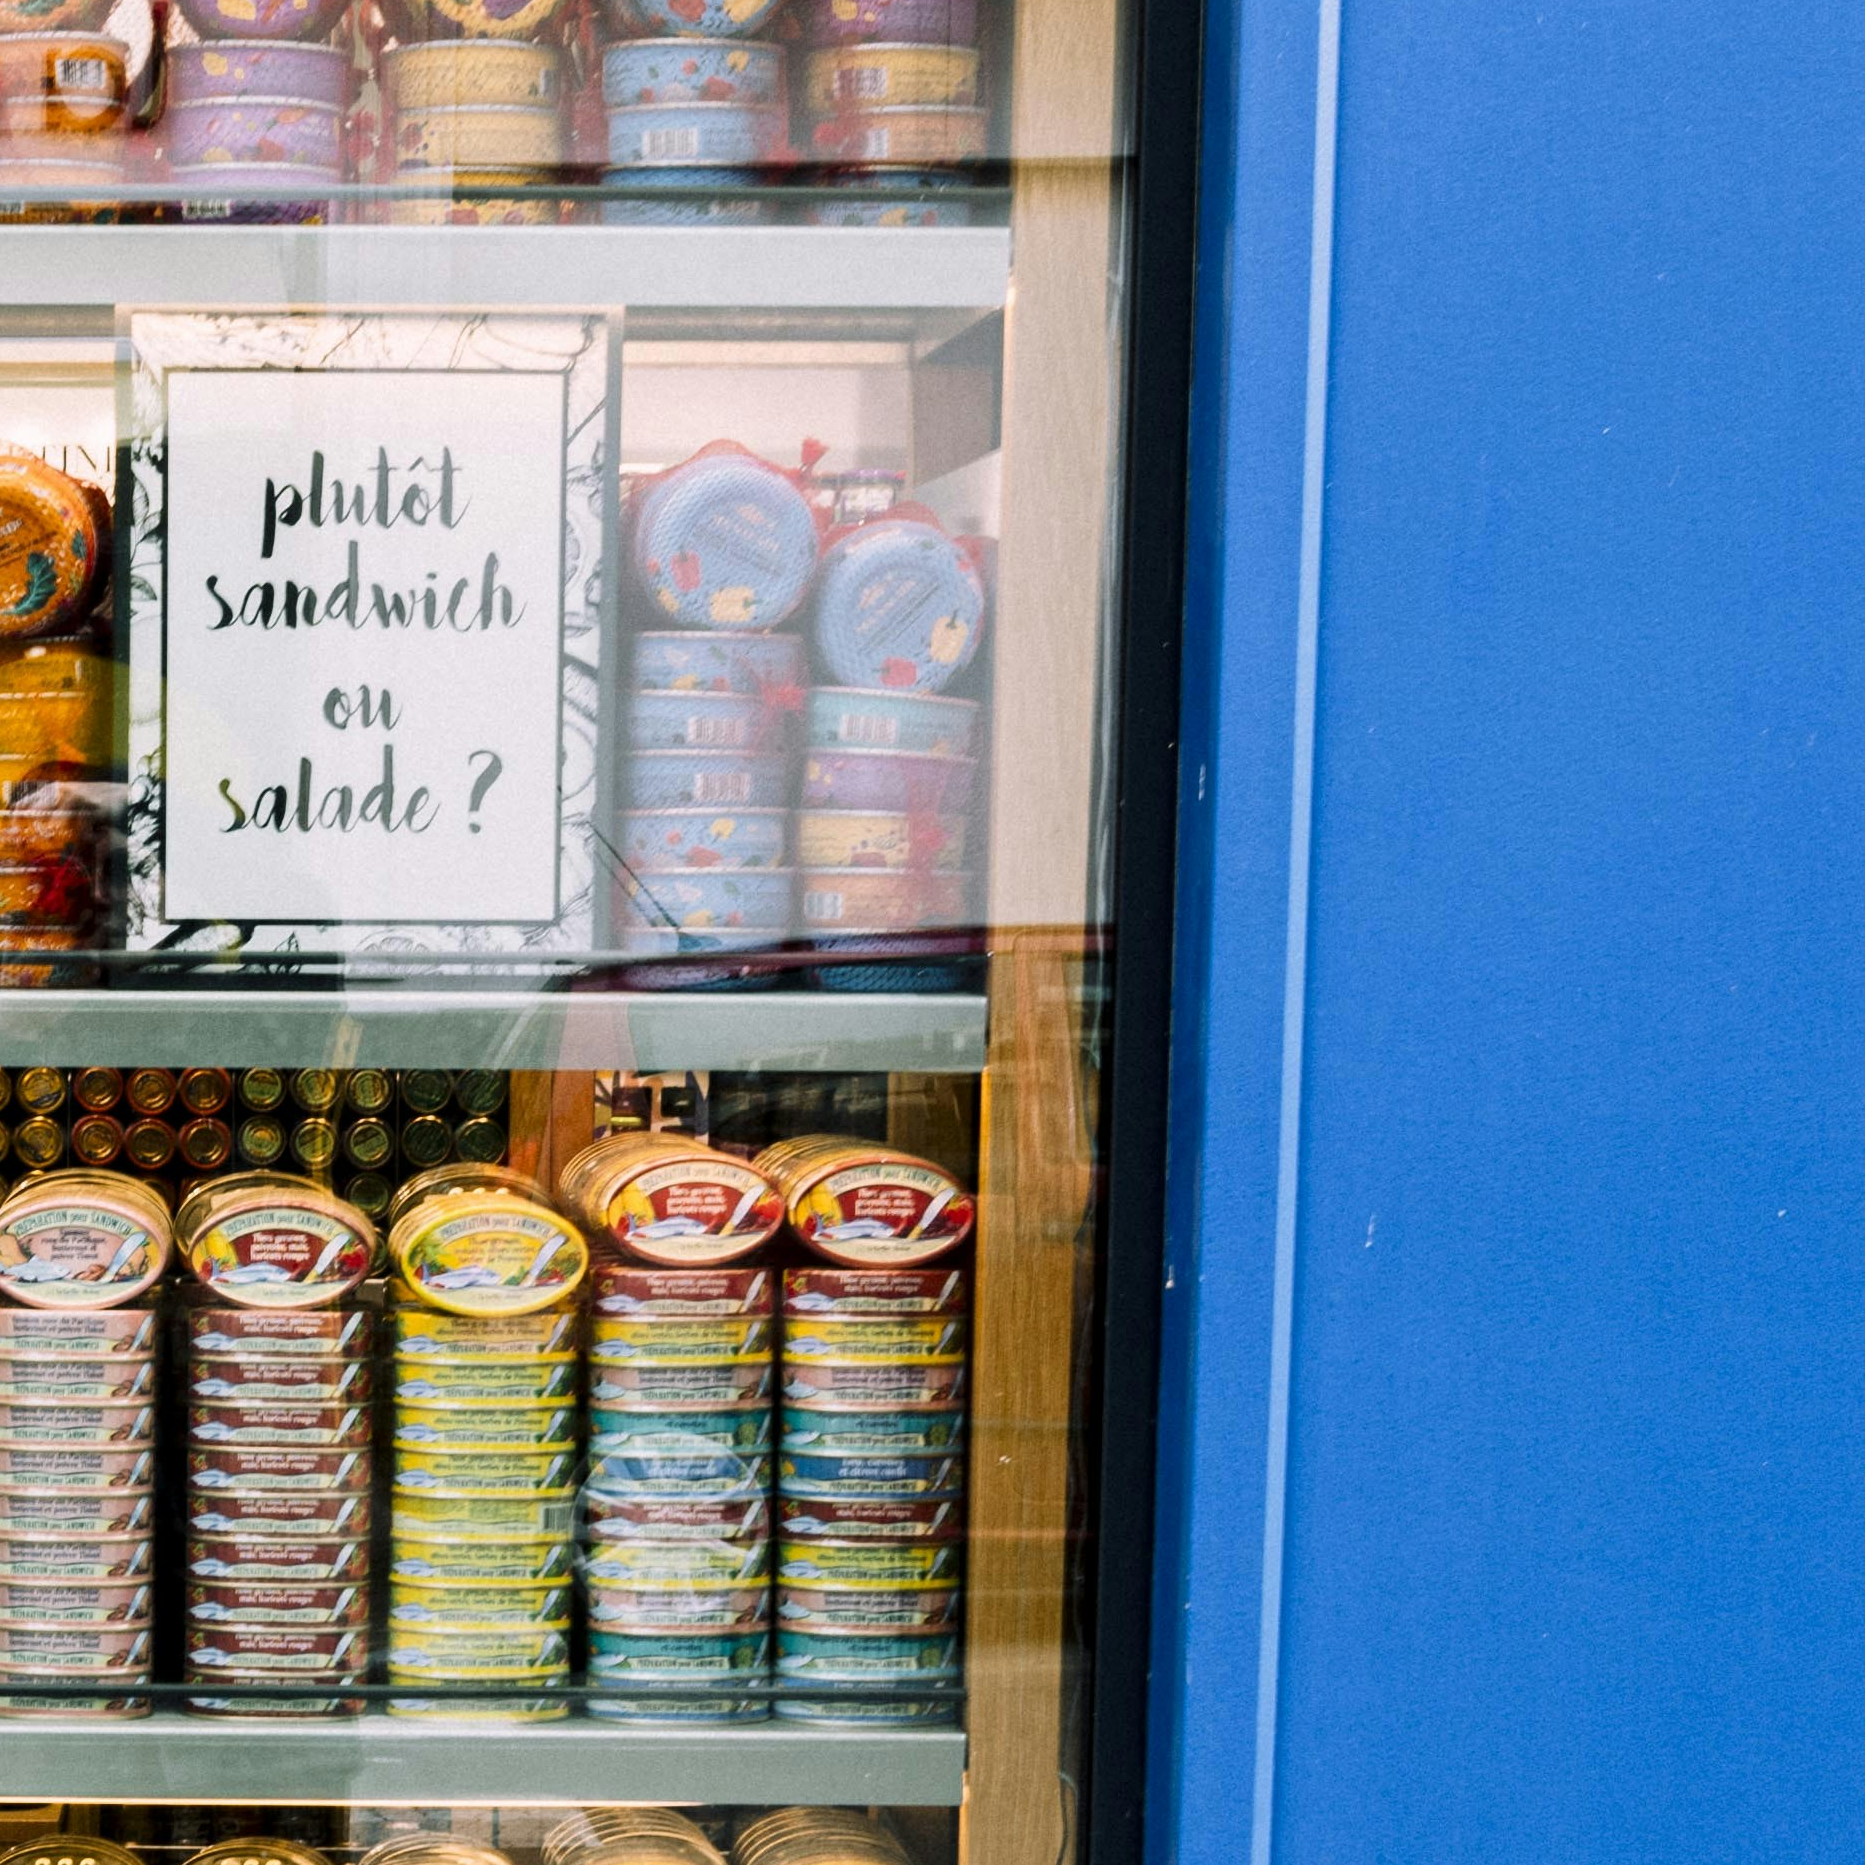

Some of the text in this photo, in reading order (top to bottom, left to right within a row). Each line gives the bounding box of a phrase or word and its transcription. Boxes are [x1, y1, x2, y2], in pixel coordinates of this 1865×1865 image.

[262, 446, 471, 558] plutôt
[206, 540, 526, 631] sandwich
[323, 684, 401, 730] ou
[218, 744, 503, 832] salade ?
